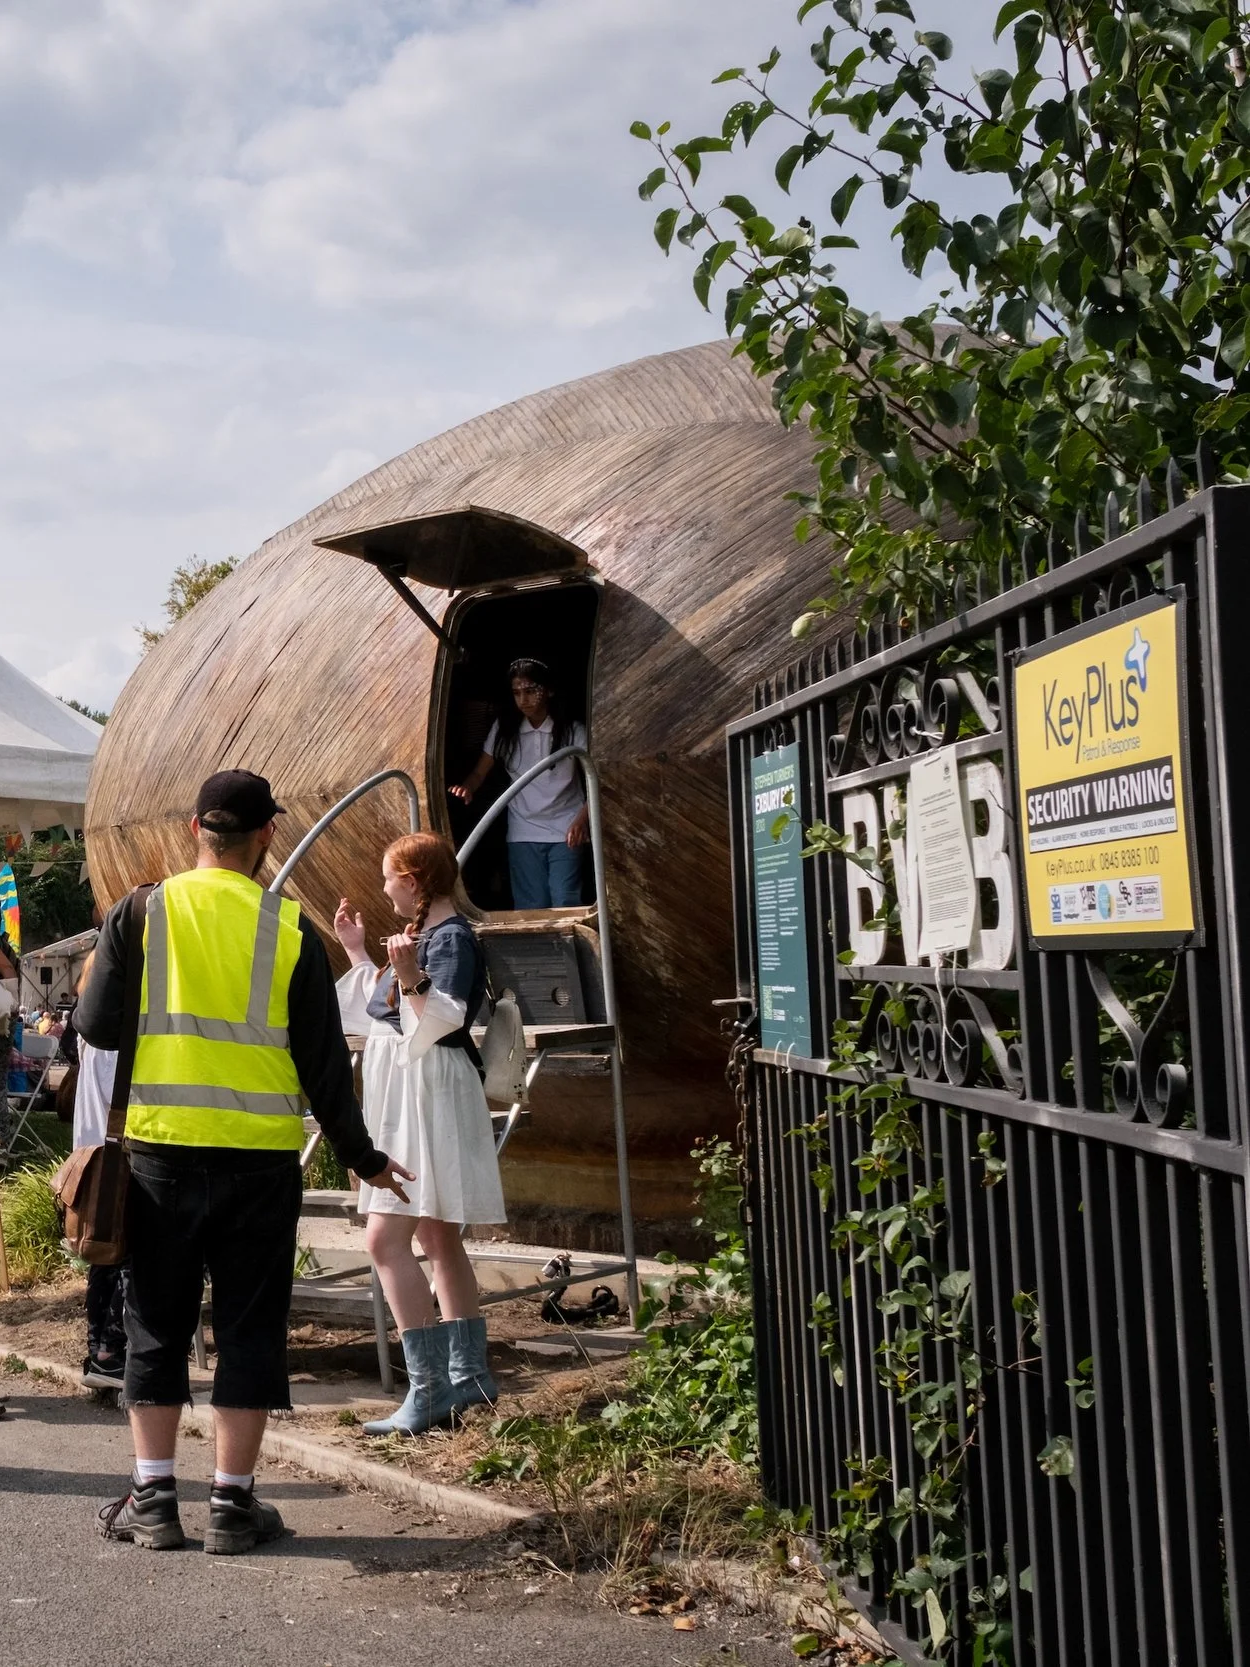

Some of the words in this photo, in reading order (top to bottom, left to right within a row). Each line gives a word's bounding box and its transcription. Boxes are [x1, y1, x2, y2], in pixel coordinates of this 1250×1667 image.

[1042, 662, 1139, 764] KeyPlus
[1107, 736, 1140, 758] Response
[1028, 783, 1090, 826] SECURITY
[1092, 765, 1174, 813] WARNING
[1046, 854, 1097, 880] KeyPlus.co.uk
[1100, 851, 1119, 871] 0845
[1121, 848, 1141, 868] 8385
[1144, 845, 1160, 865] 100
